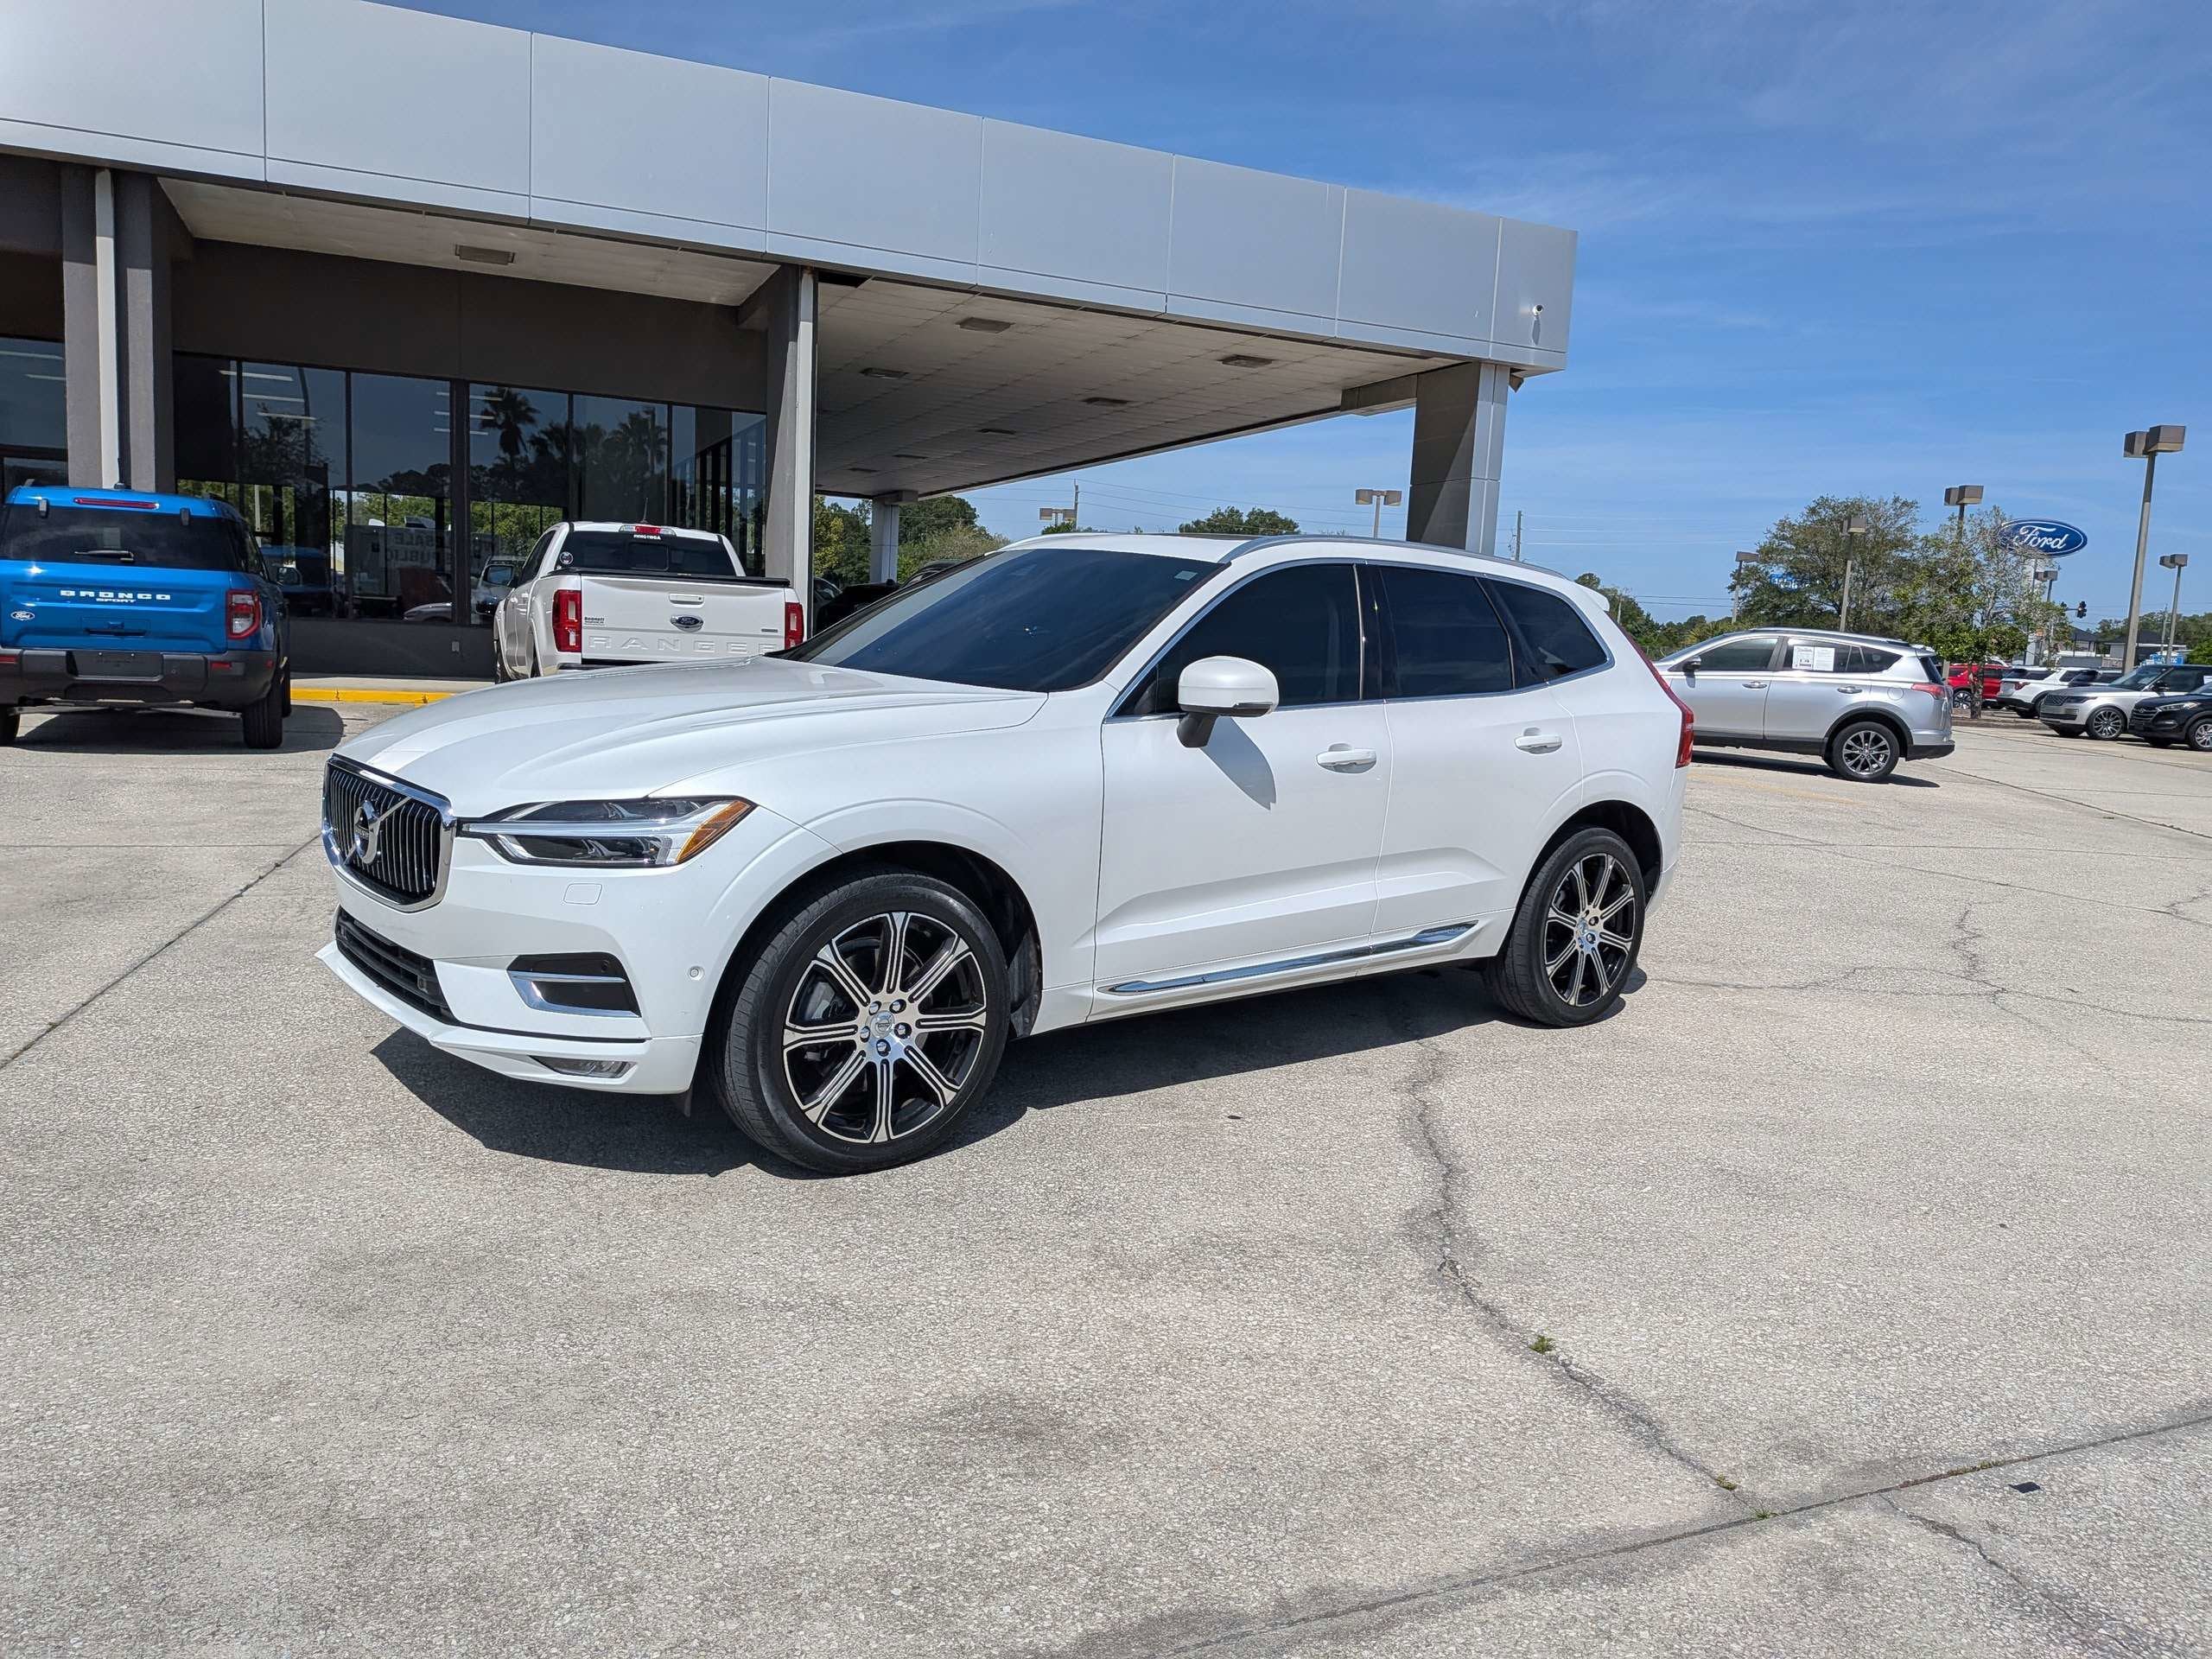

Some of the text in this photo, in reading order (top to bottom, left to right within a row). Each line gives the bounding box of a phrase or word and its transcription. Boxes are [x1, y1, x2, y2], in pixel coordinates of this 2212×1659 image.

[2013, 525, 2069, 550] Ford
[60, 590, 171, 601] BRONCO
[589, 636, 778, 654] RANGER
